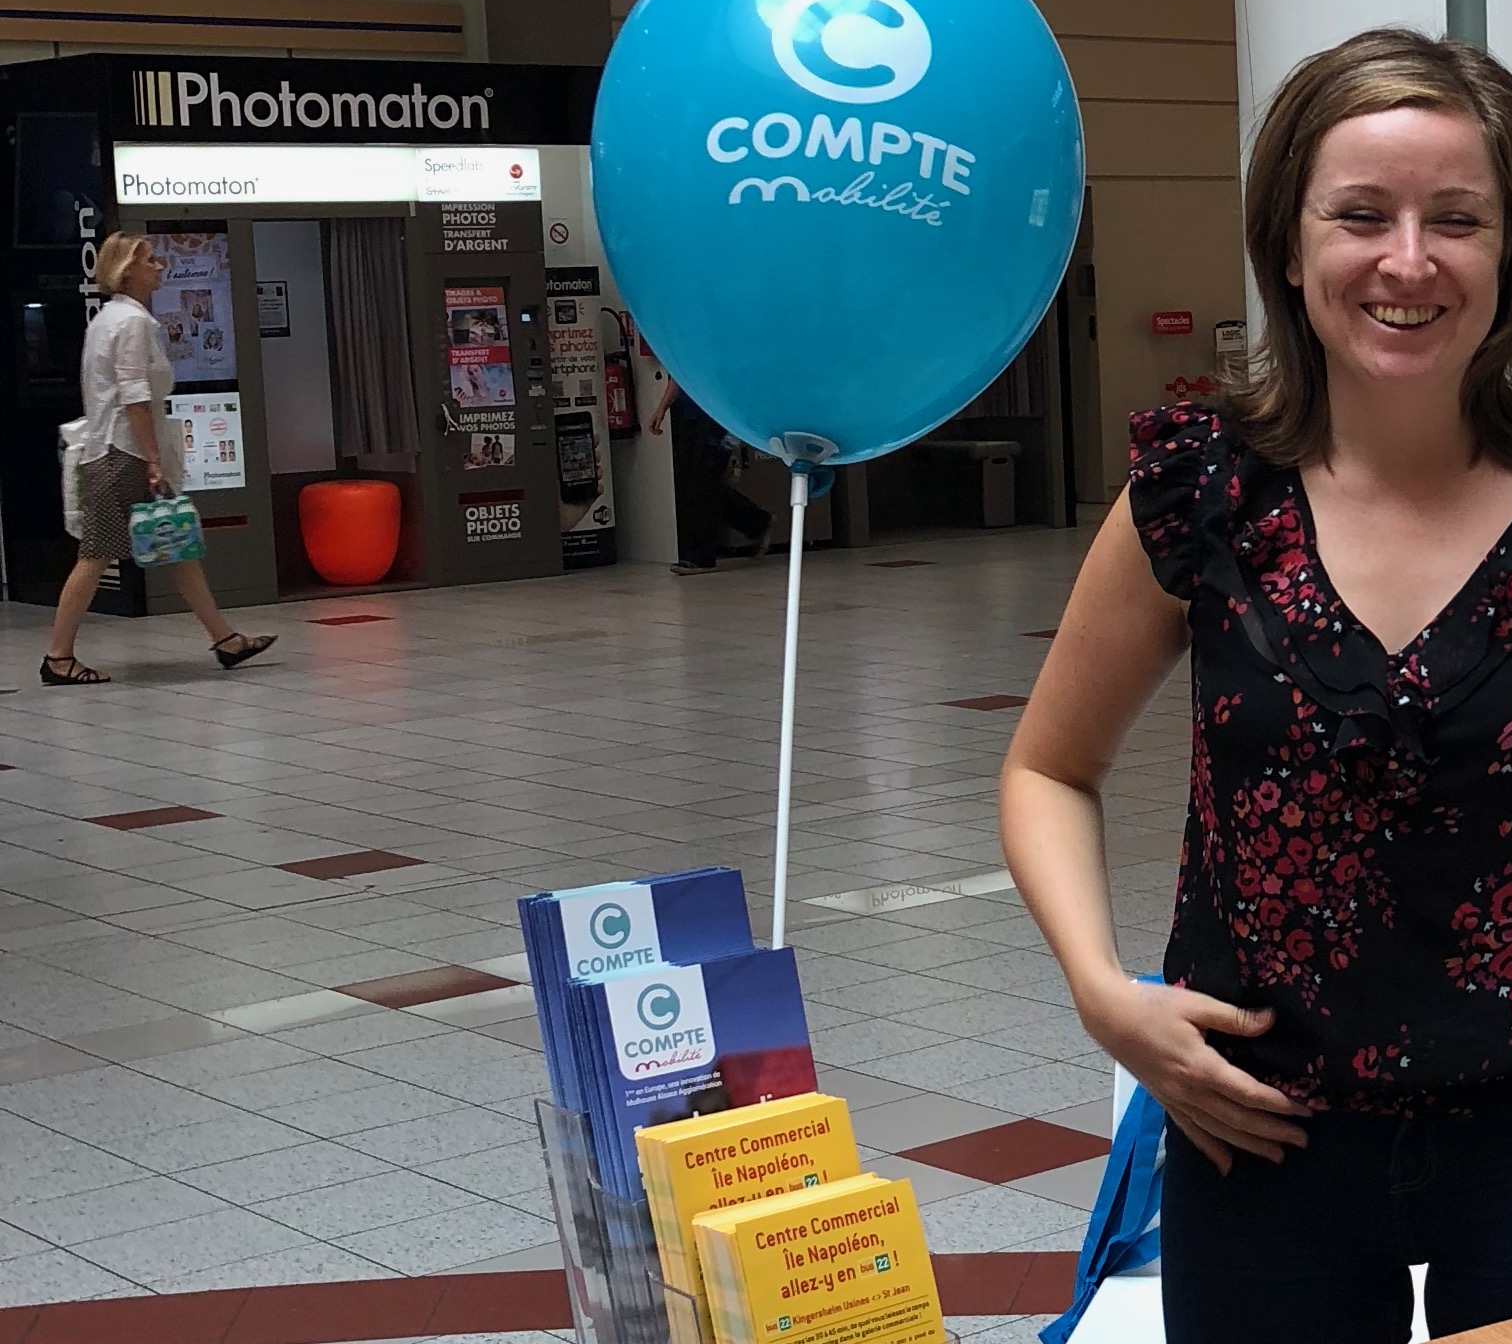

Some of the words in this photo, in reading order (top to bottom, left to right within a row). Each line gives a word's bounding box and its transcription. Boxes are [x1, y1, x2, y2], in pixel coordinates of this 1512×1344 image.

[706, 112, 976, 196] COMPTE
[728, 172, 952, 226] mobilité
[443, 213, 496, 224] PHOTOS
[444, 229, 491, 238] TRANSFERT
[444, 239, 508, 251] D'ARGENT
[460, 411, 514, 422] IMPRIMEZ
[480, 422, 515, 431] PHOTOS
[466, 504, 520, 520] OBJETS
[467, 519, 520, 534] PHOTO
[577, 947, 655, 976] COMPTE
[624, 1027, 707, 1058] COMPTE
[684, 1141, 737, 1170] Centre
[739, 1117, 830, 1156] Commercial
[712, 1166, 734, 1190] Île
[736, 1149, 815, 1185] Napoléon,
[755, 1224, 807, 1250] Centre
[810, 1196, 900, 1235] Commercial
[782, 1248, 805, 1270] Île
[807, 1232, 885, 1264] Napoléon,
[780, 1272, 834, 1299] allez-y
[836, 1266, 856, 1283] en
[859, 1261, 874, 1273] bus
[876, 1255, 889, 1270] 22
[892, 1249, 899, 1266] !
[780, 1318, 792, 1330] 22
[842, 1294, 869, 1310] Usines
[882, 1287, 891, 1299] St
[891, 1282, 910, 1296] Jean
